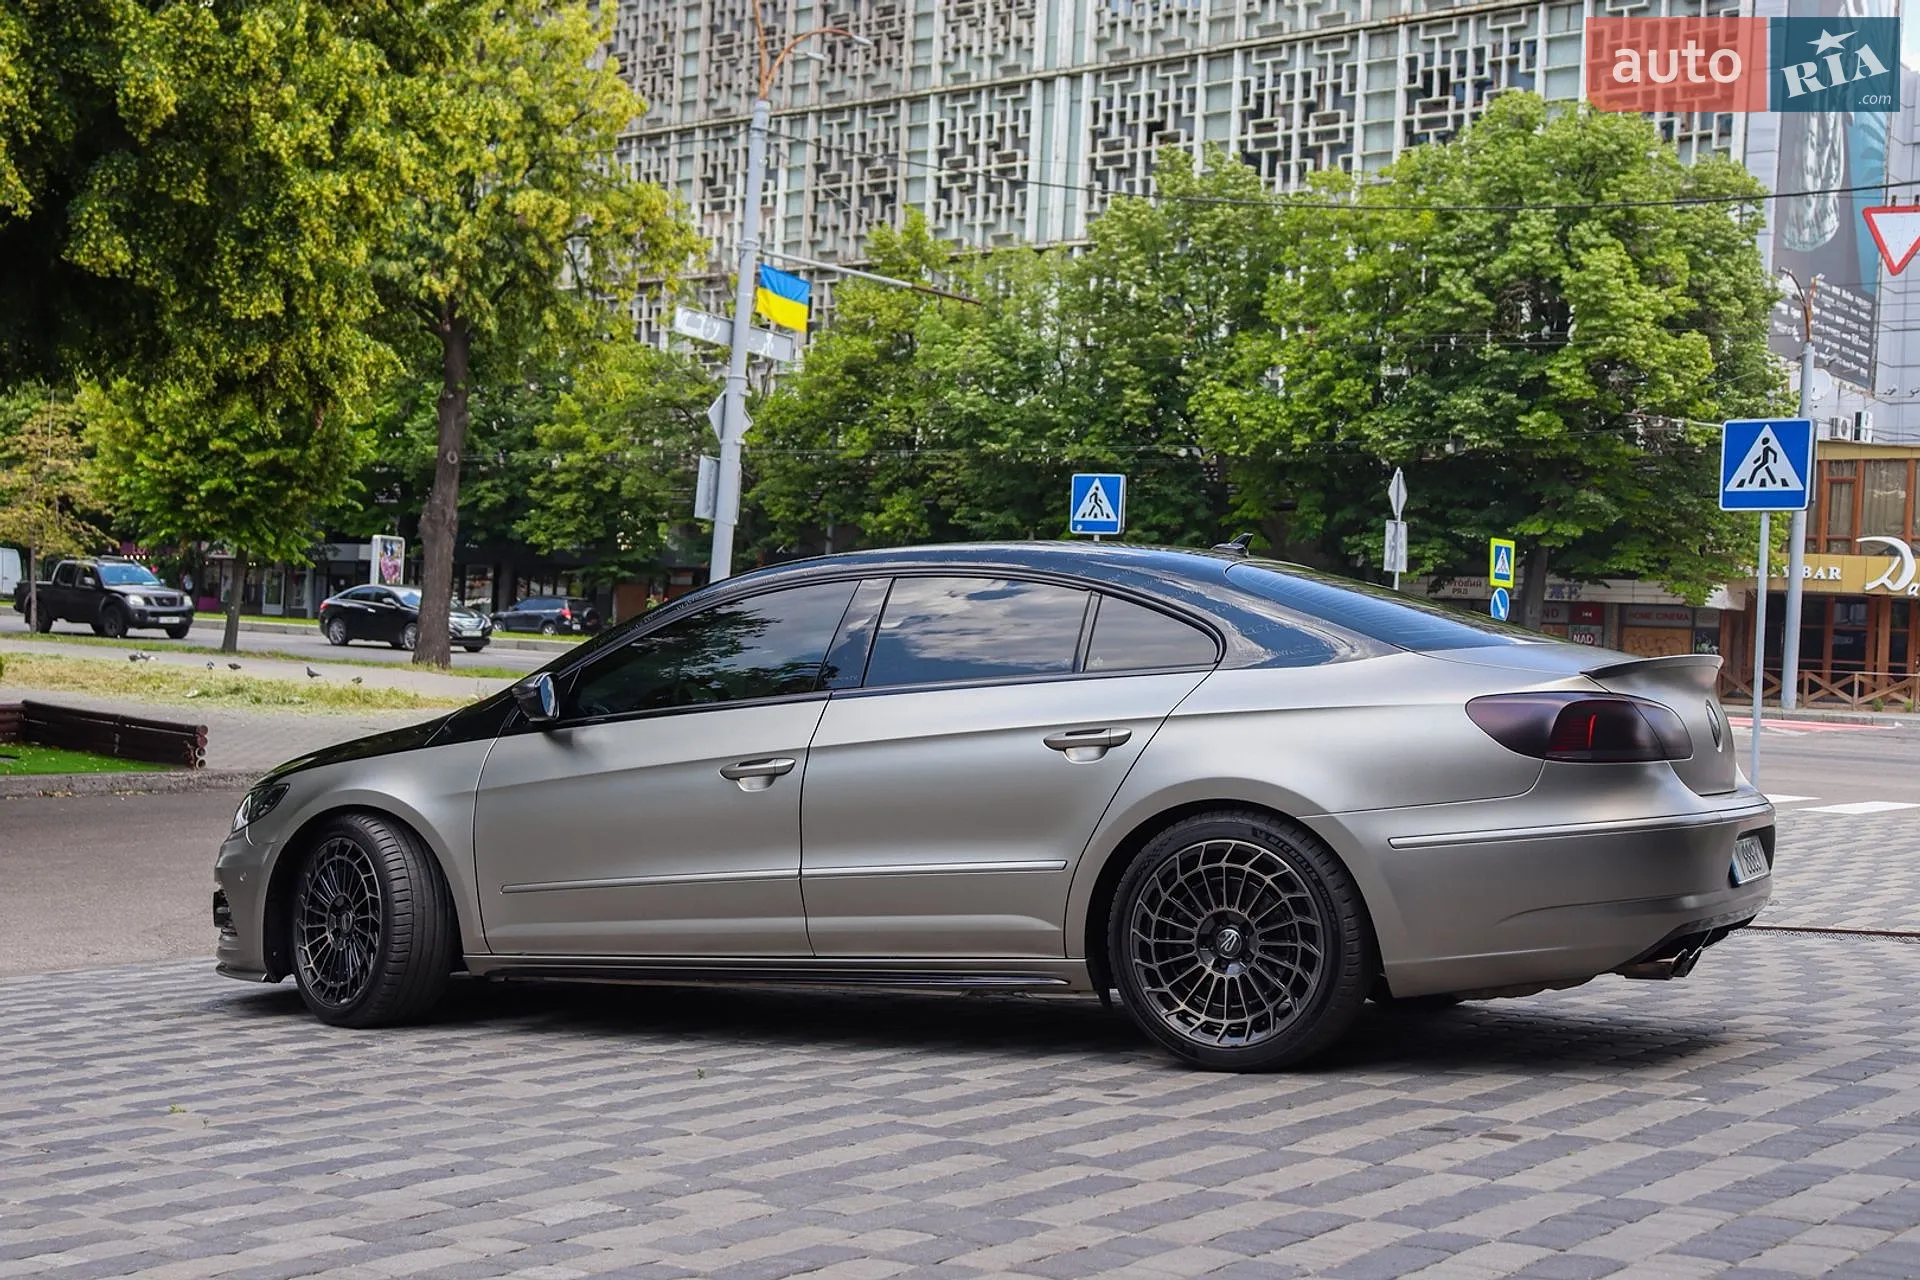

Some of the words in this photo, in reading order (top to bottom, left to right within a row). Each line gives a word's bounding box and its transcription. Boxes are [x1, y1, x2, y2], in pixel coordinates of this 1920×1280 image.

[1802, 566, 1842, 580] BAR
[1655, 612, 1690, 621] CINEMA
[1572, 632, 1594, 645] NAD
